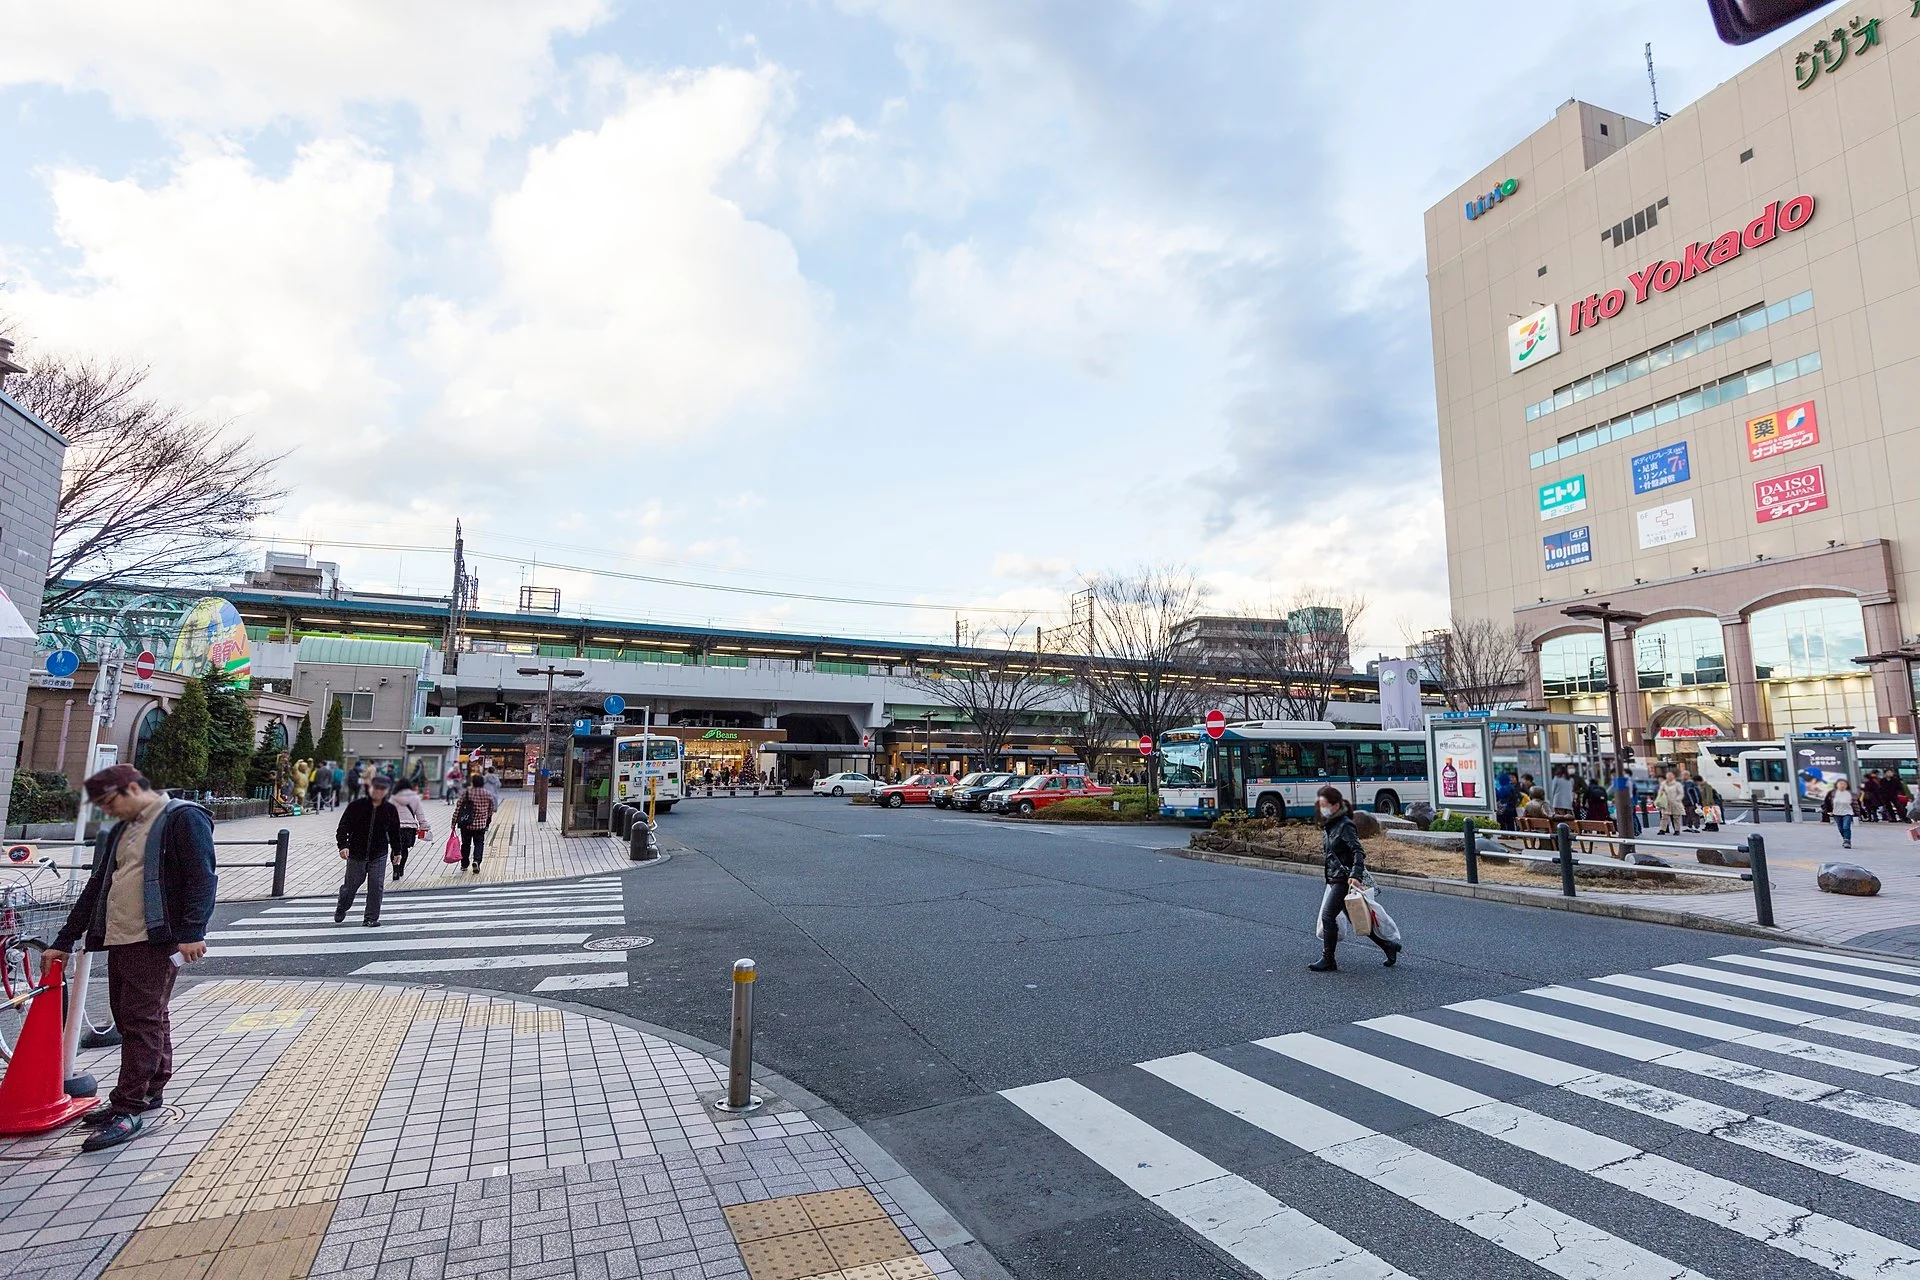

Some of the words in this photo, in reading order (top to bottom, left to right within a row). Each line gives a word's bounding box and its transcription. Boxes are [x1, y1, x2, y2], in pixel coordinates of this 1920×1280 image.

[1796, 18, 1880, 90] リリオ
[1569, 288, 1626, 336] Ito
[1627, 194, 1816, 304] Yokado
[1753, 418, 1775, 439] 薬
[1543, 479, 1581, 506] ニトリ
[1760, 474, 1816, 497] DAISO
[1785, 485, 1815, 498] JAPAN
[1769, 500, 1817, 518] ダイソー
[1572, 530, 1584, 539] 4F
[715, 730, 738, 739] Beans
[630, 761, 667, 769] TONBUS
[1458, 759, 1477, 770] HOT!
